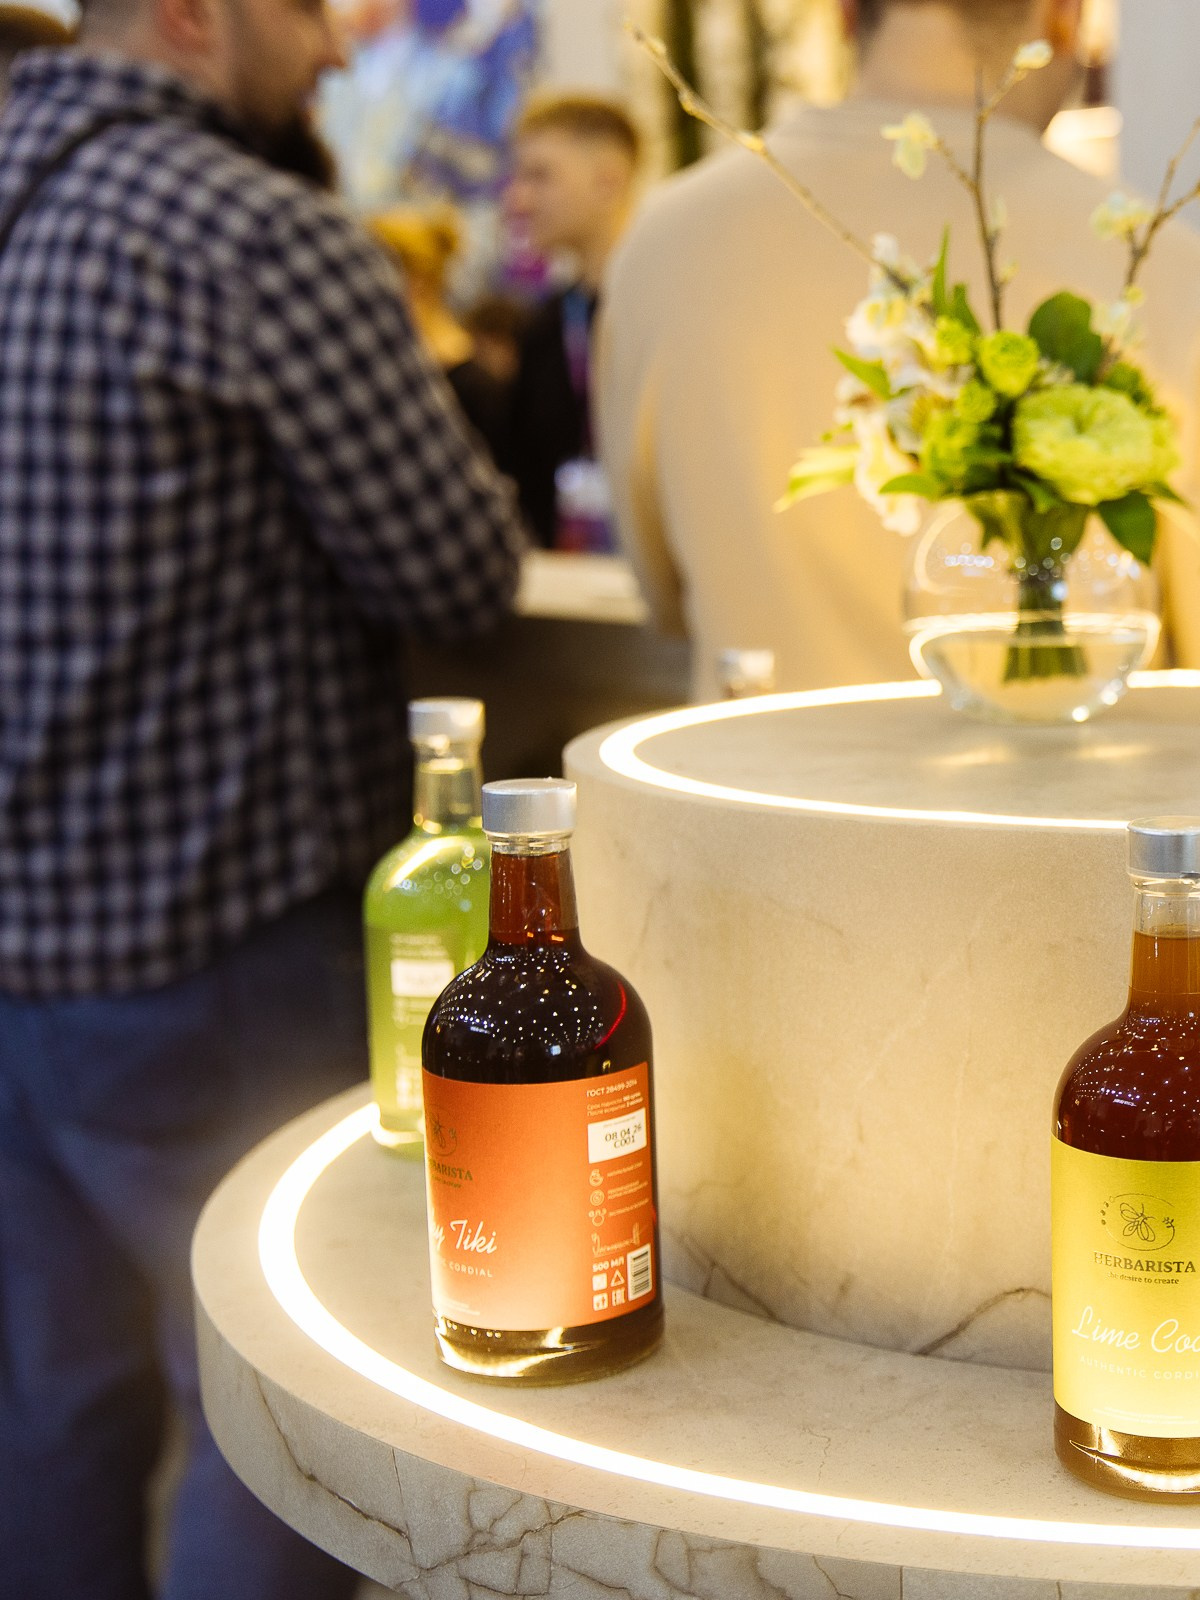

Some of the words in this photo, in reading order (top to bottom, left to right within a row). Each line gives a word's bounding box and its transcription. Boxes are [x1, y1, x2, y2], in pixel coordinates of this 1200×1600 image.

[586, 1088, 605, 1098] ГОСТ
[449, 1218, 498, 1255] Tiki
[448, 1261, 494, 1278] CORDIAL
[1093, 1251, 1197, 1273] HERBARISTA
[1119, 1273, 1142, 1283] desire
[1153, 1277, 1180, 1285] create
[1071, 1304, 1141, 1351] Lime
[1079, 1355, 1147, 1379] AUTHENTIC
